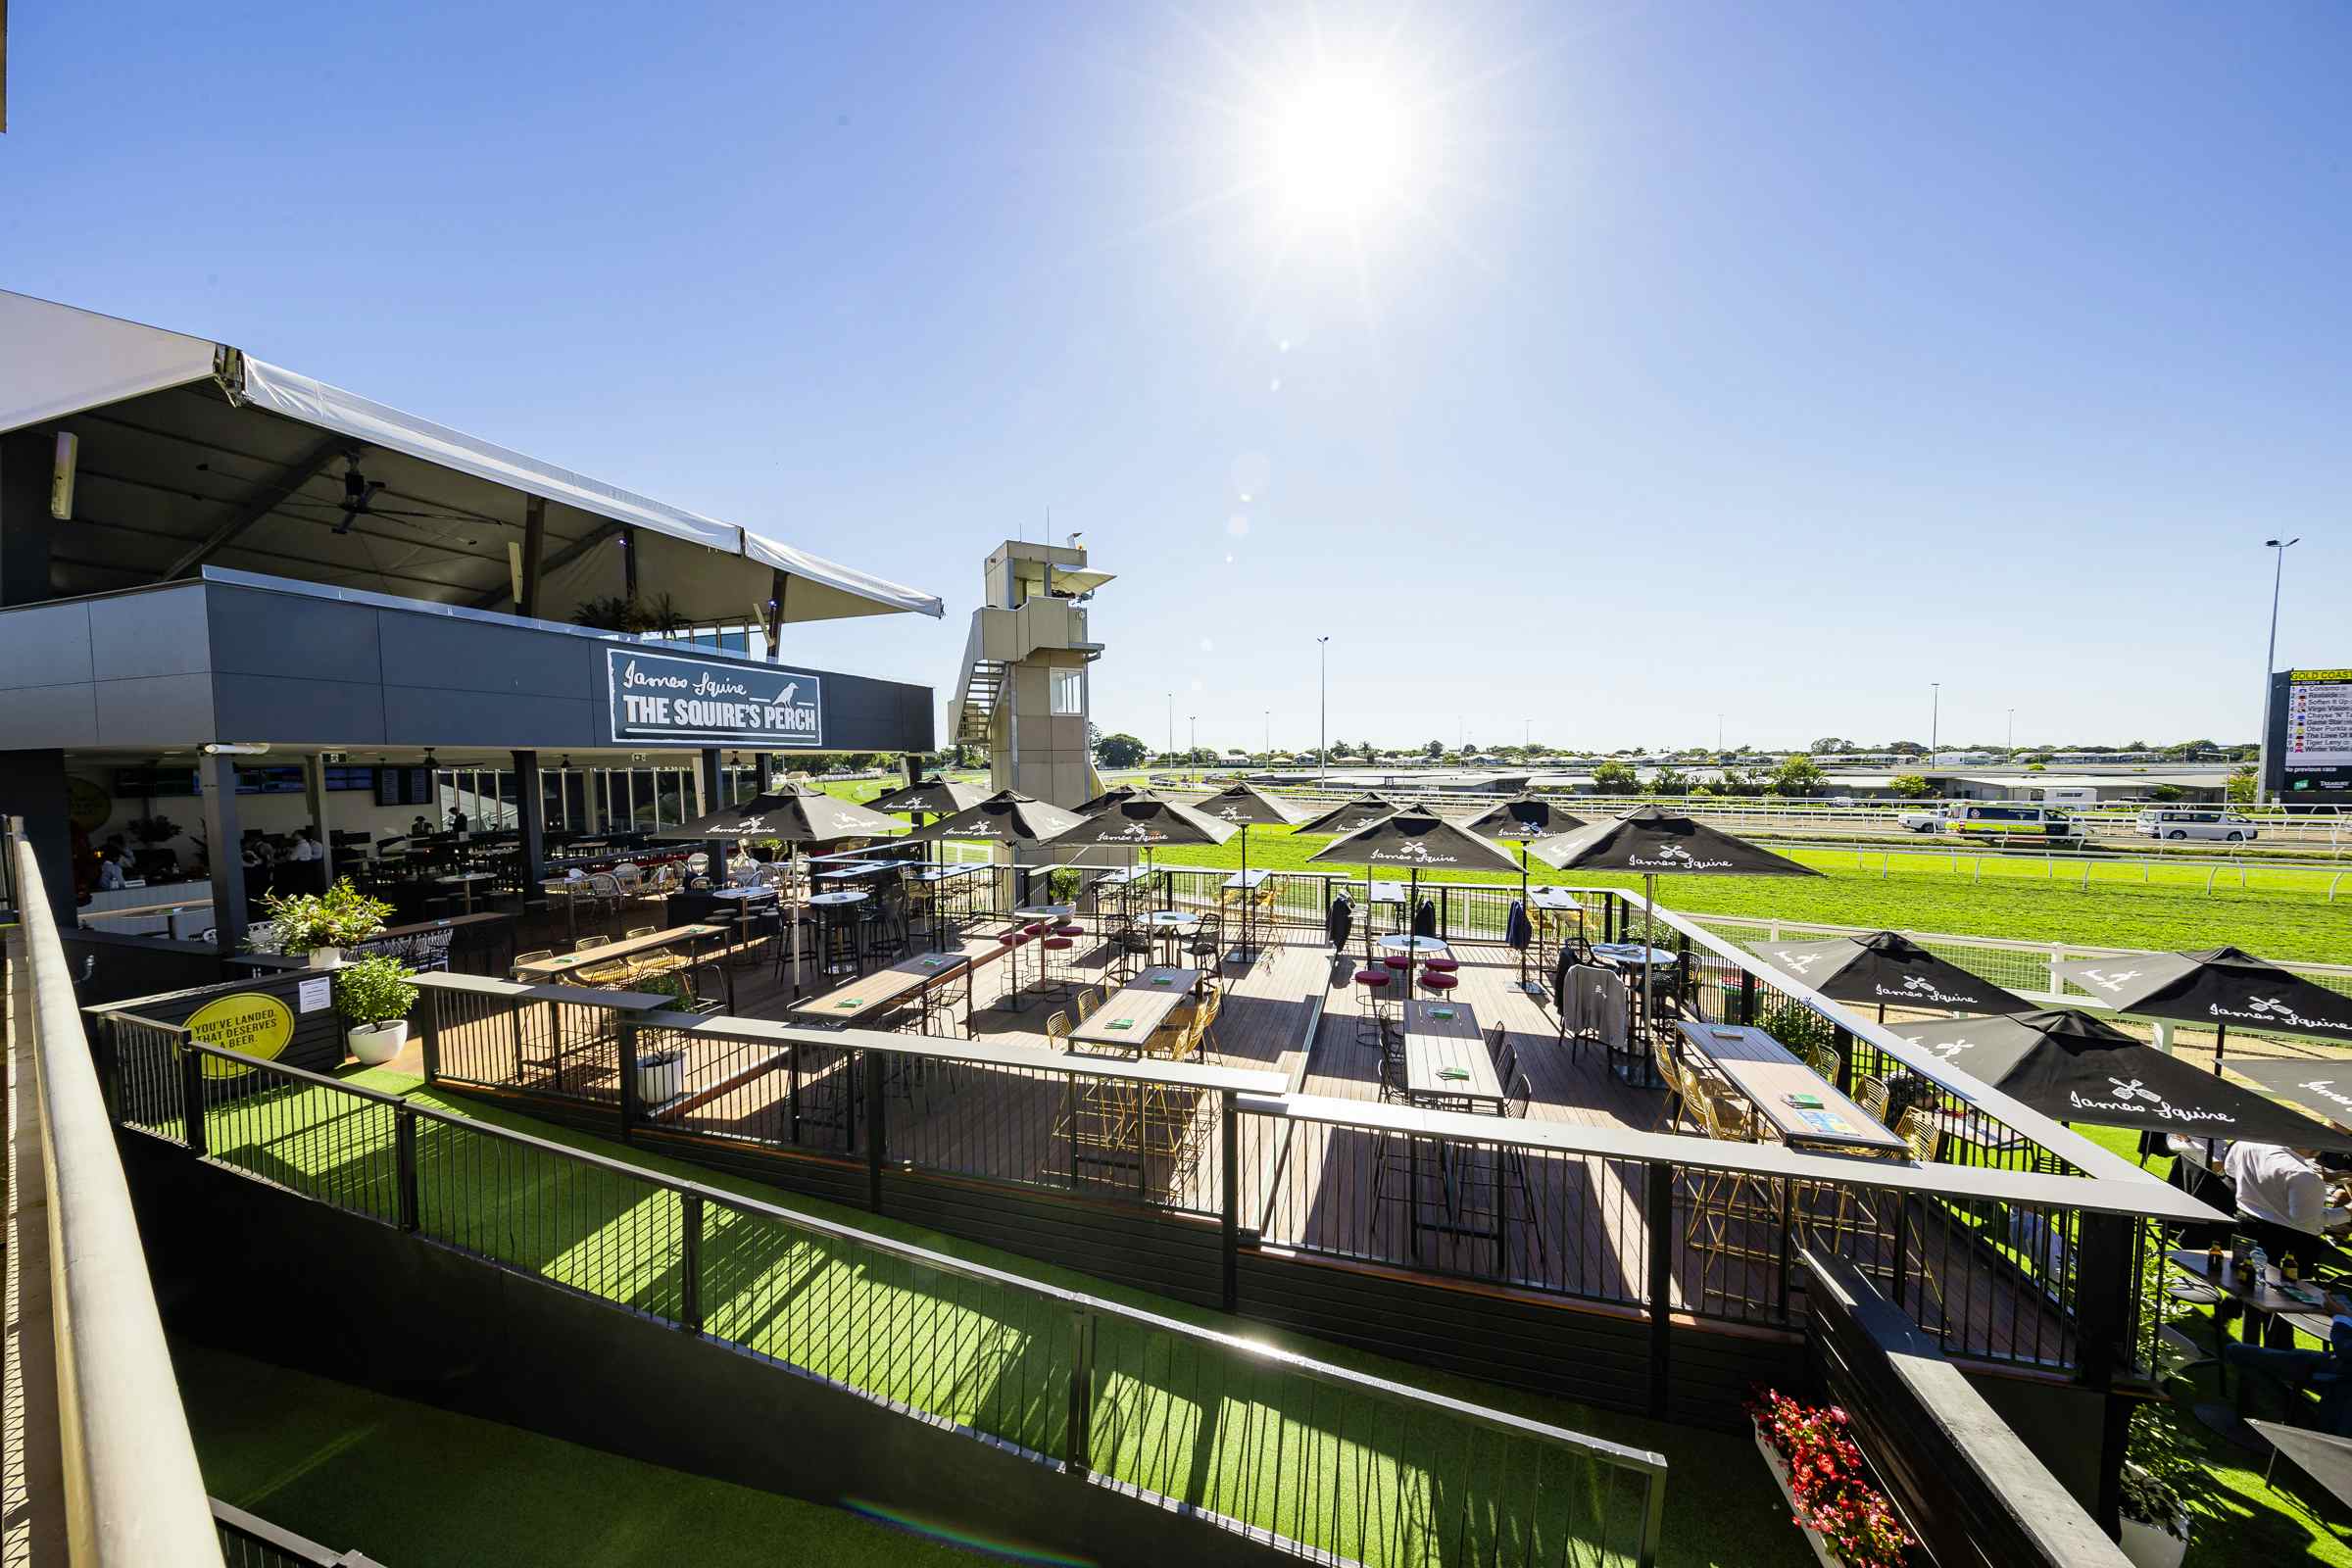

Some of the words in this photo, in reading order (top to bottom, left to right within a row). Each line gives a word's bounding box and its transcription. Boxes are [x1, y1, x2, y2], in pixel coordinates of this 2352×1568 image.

[622, 660, 688, 689] James
[692, 671, 748, 698] Squire
[622, 694, 671, 724] THE
[673, 698, 761, 729] SQUIRE'S
[764, 705, 816, 731] PERCH
[1096, 831, 1133, 842] James
[1370, 848, 1412, 859] James
[1412, 853, 1458, 862] Squire
[1628, 854, 1677, 866] James
[1680, 856, 1733, 868] Squire
[1876, 983, 1923, 998] James
[1927, 990, 1979, 1004] Squire
[194, 1018, 233, 1036] YOU'VE
[2209, 1003, 2275, 1021] James
[2280, 1013, 2352, 1030] Squire
[195, 1030, 223, 1044] THAT
[226, 1018, 277, 1038] DESERVES
[219, 1041, 226, 1050] A
[228, 1034, 259, 1050] BEER.
[2070, 1090, 2146, 1113] James
[2151, 1101, 2236, 1124] Squire
